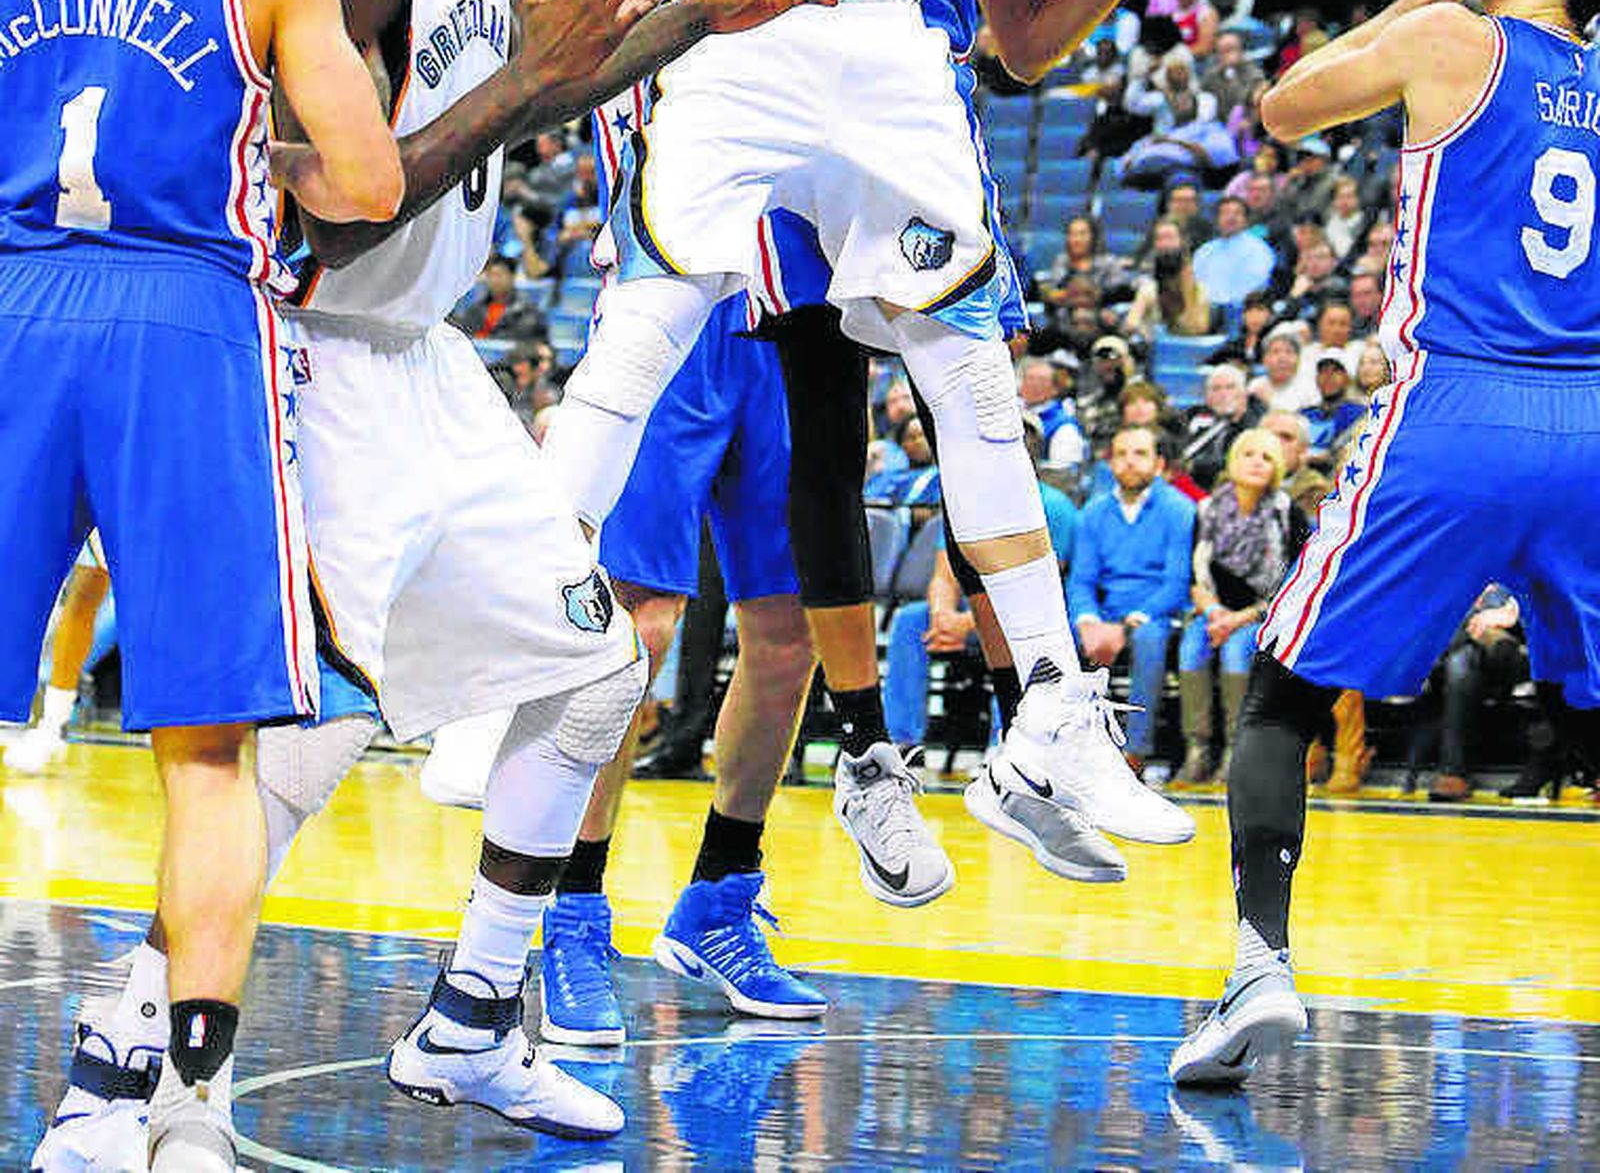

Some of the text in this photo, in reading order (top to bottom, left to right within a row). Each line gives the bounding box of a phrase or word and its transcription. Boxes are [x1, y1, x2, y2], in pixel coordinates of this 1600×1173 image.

[55, 86, 111, 230] 1
[1536, 81, 1600, 136] SARI
[1521, 147, 1596, 279] 9
